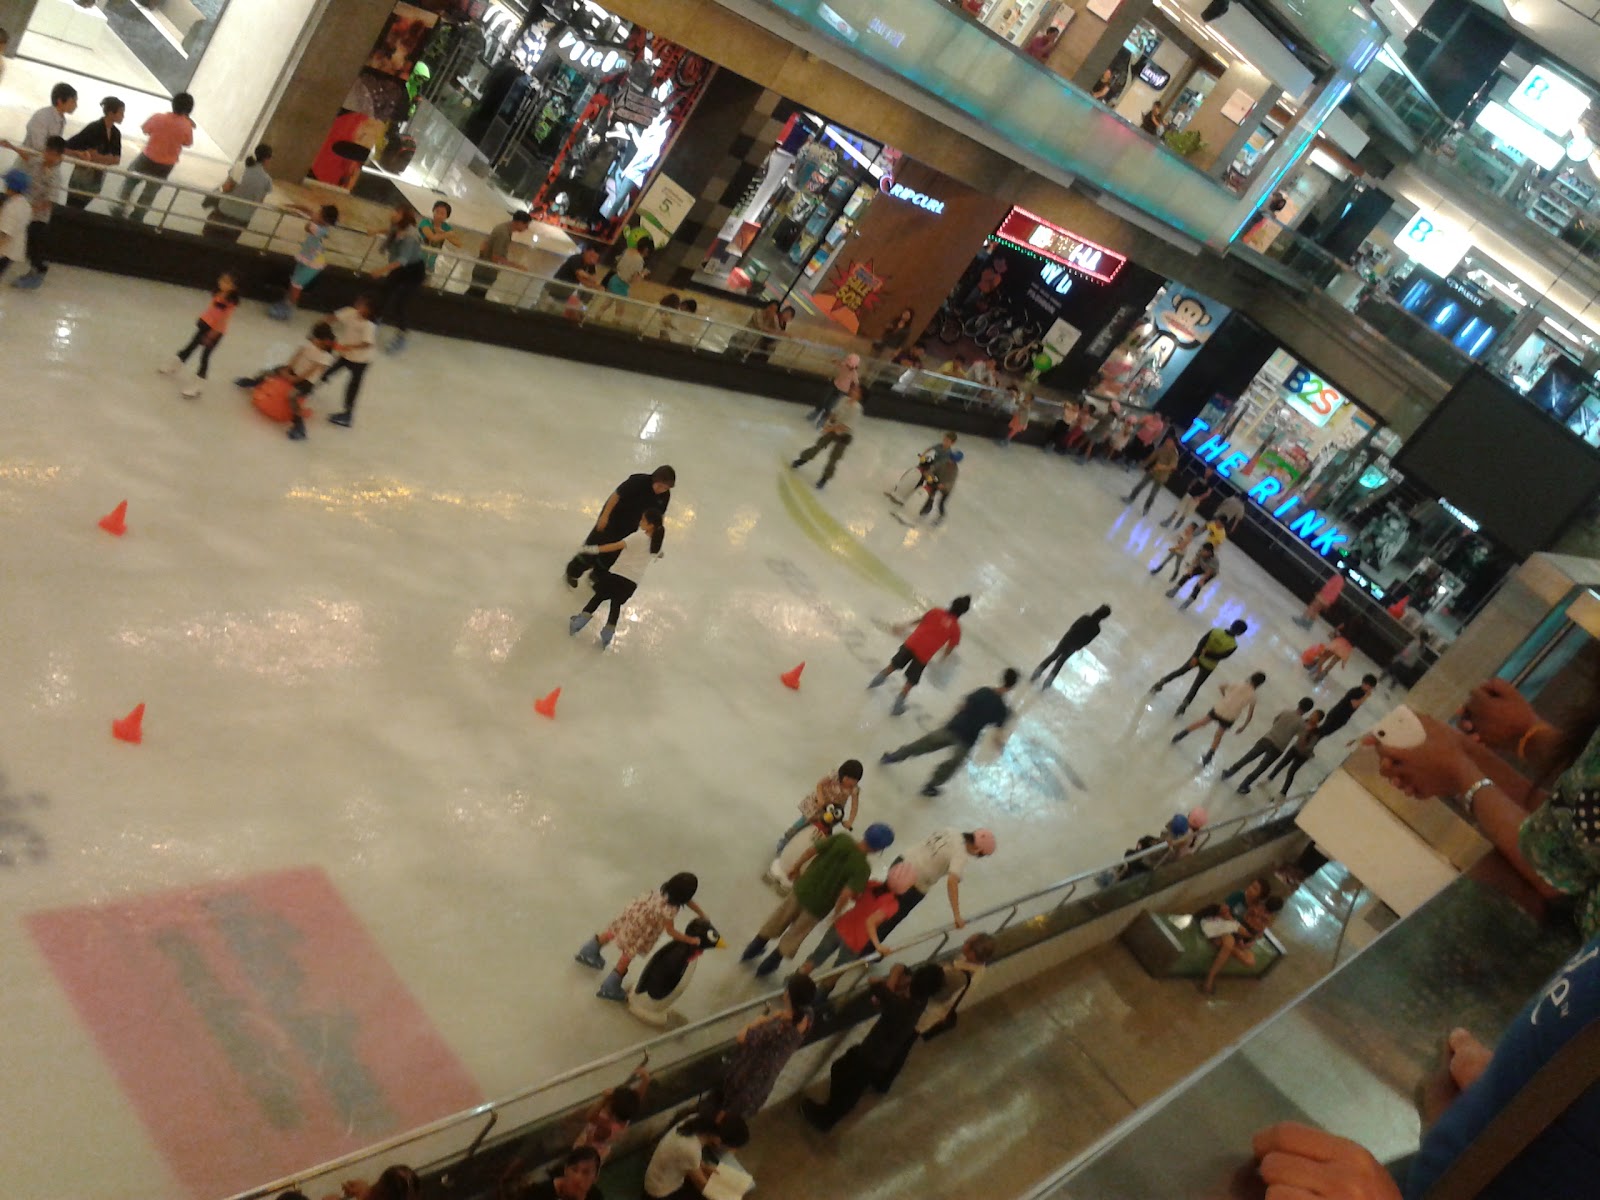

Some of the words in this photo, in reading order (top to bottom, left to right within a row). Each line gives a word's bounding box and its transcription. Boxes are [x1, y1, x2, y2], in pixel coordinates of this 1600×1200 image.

[1283, 364, 1339, 416] B2S
[1180, 417, 1249, 478] THE
[1248, 475, 1348, 556] RINK
